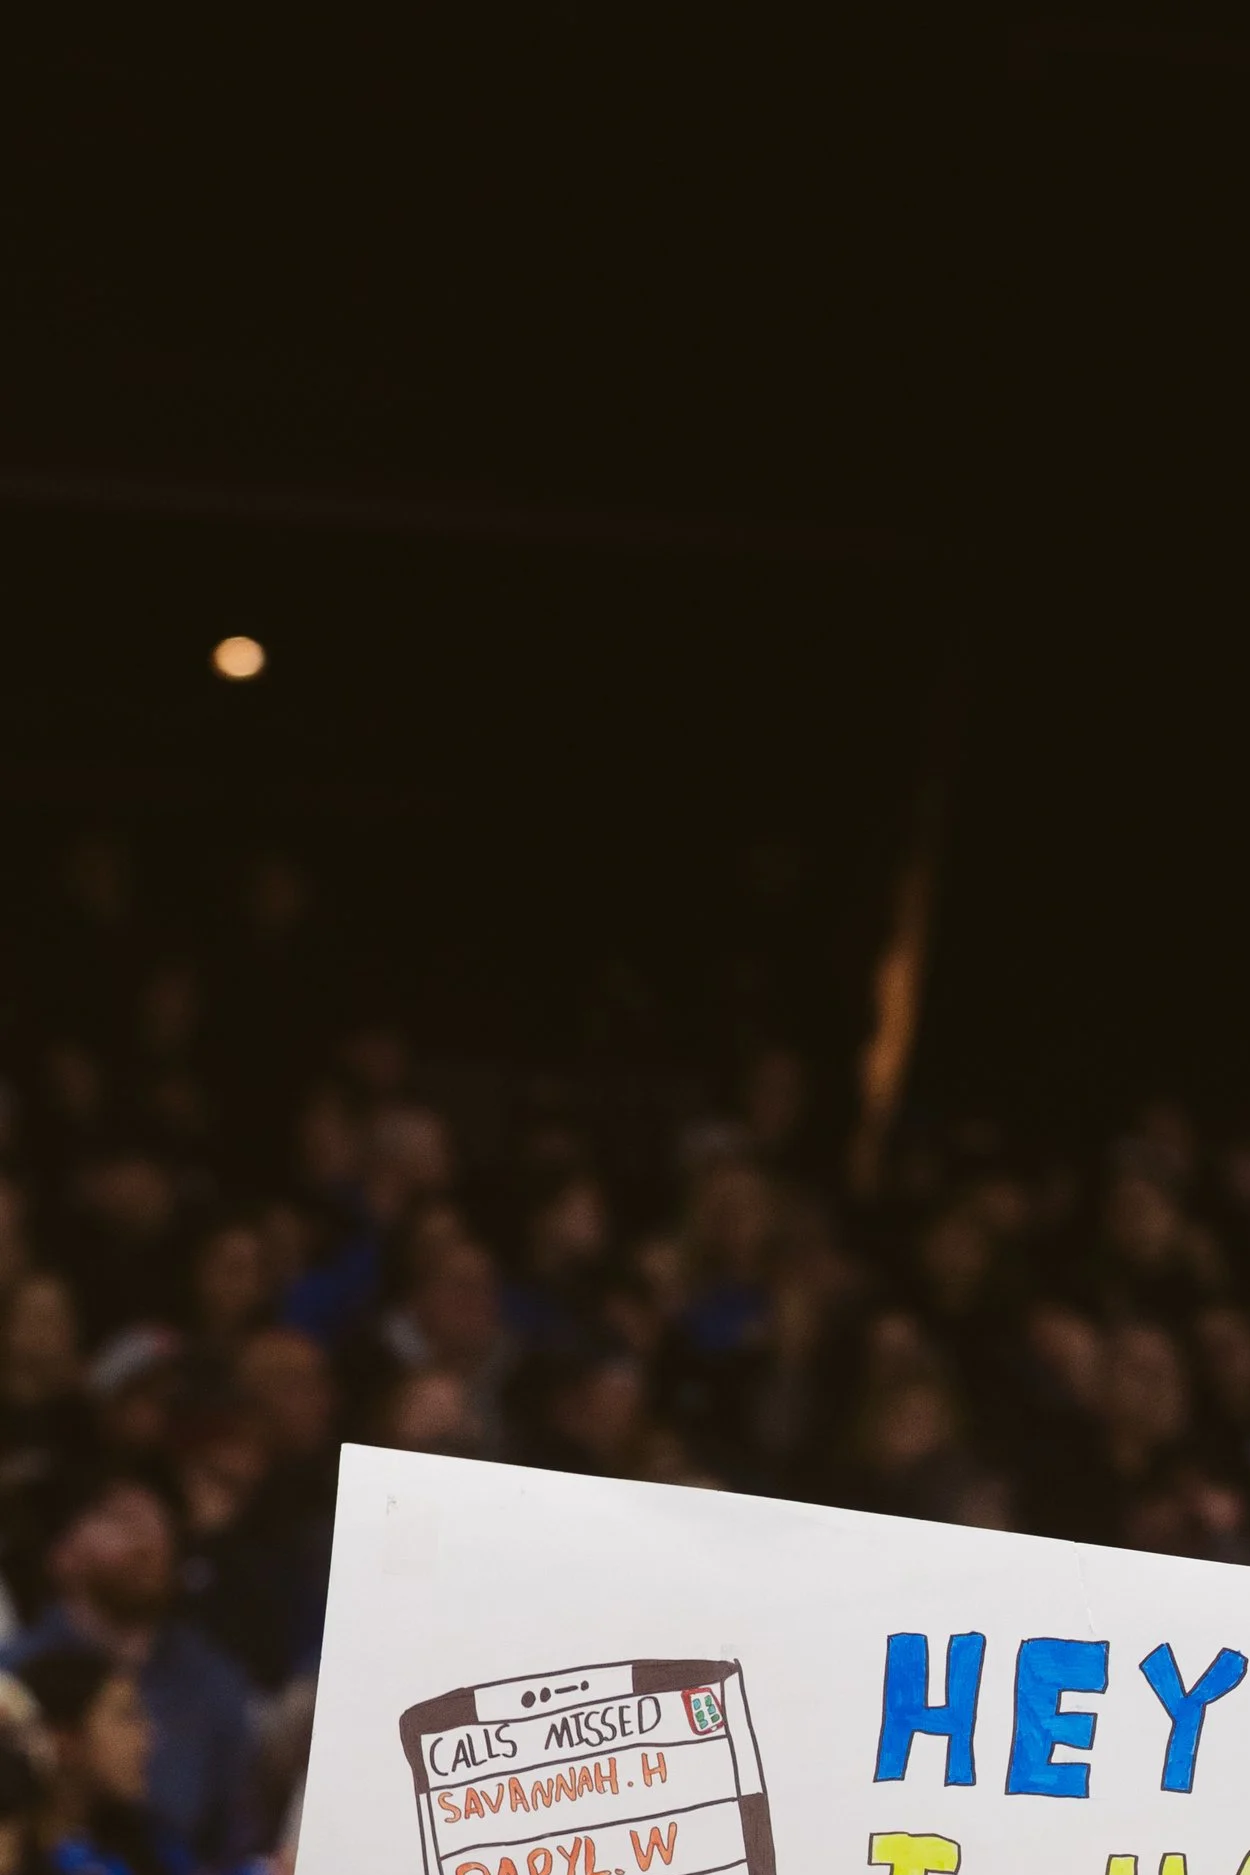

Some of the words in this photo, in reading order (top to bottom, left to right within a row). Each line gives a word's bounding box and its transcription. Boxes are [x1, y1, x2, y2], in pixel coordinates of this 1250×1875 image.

[430, 1723, 517, 1776] CALLS
[544, 1696, 661, 1746] MISSED
[873, 1632, 1248, 1798] HEY
